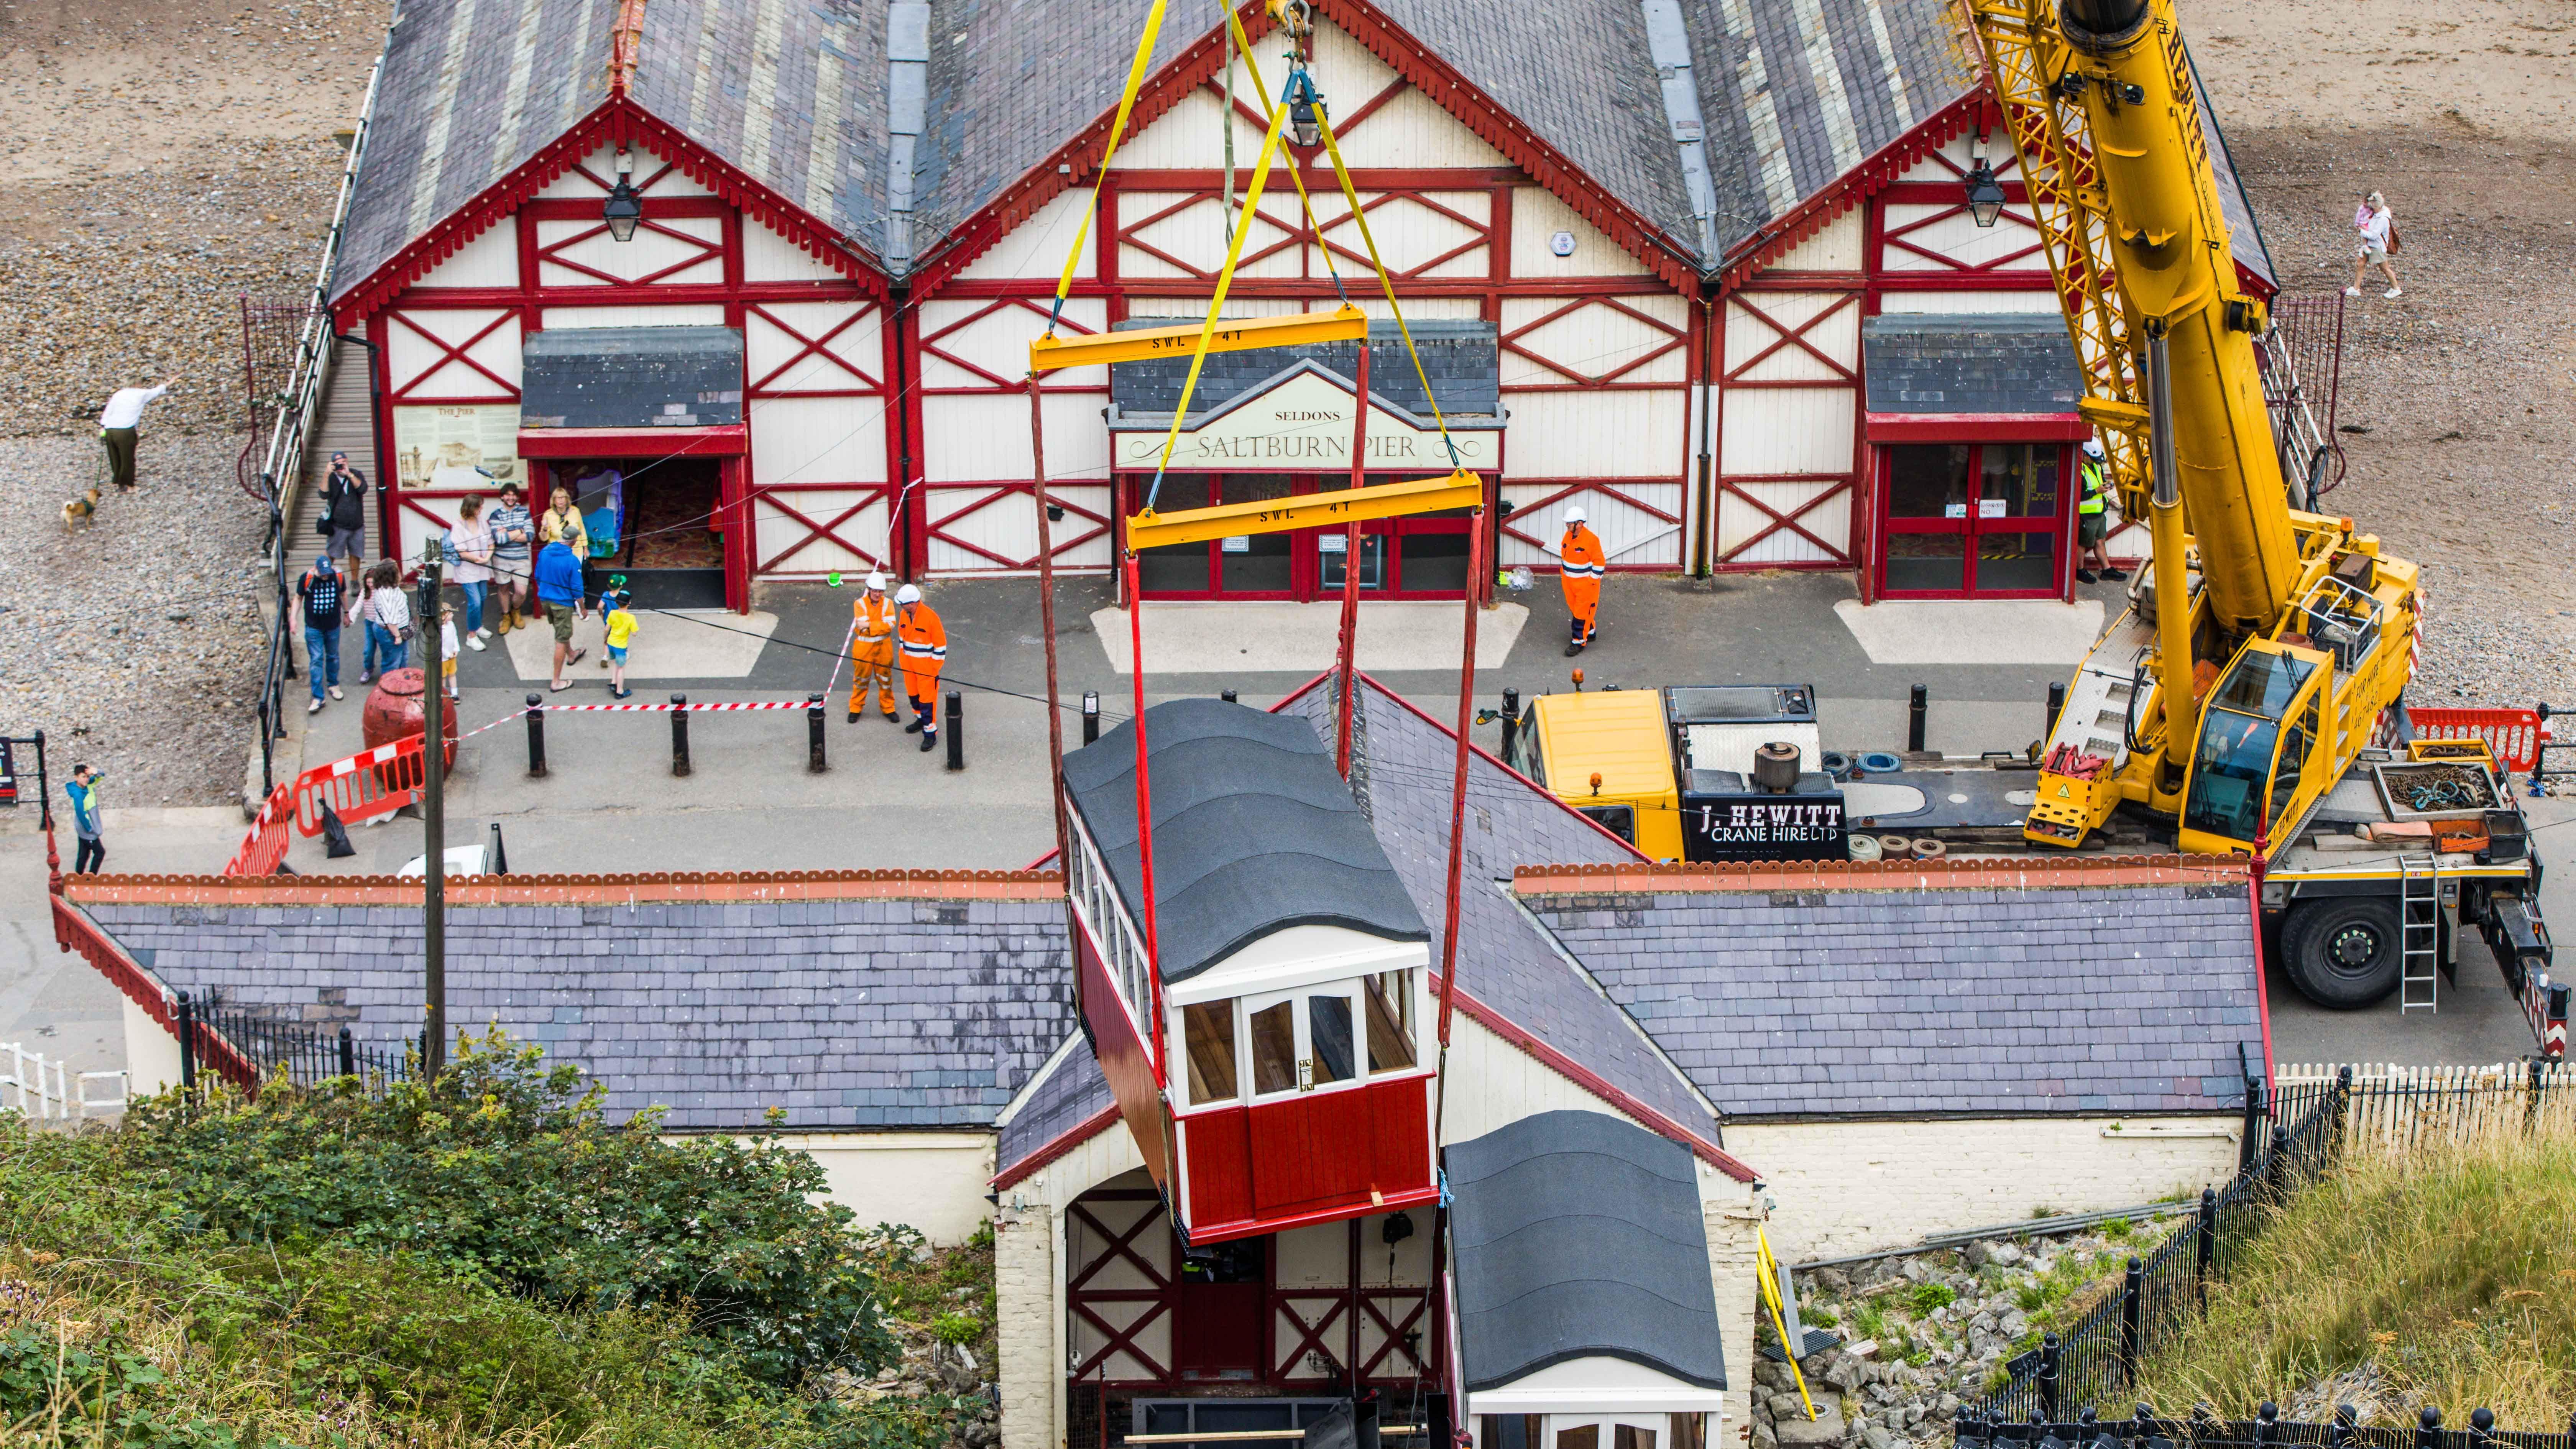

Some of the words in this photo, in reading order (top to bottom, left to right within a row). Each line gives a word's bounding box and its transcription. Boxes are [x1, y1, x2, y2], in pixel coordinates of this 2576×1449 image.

[2167, 25, 2207, 173] HEWITT
[1275, 411, 1340, 421] SELDONS
[1198, 436, 1347, 457] SALTBURN
[1364, 436, 1416, 457] PIER
[2356, 677, 2366, 702] FOR
[2367, 660, 2380, 688] HIRE
[1700, 805, 1720, 833] J.
[1730, 805, 1840, 826] HEWITT
[1712, 827, 1767, 841] CRANE
[1773, 827, 1809, 841] HIRE
[1810, 827, 1837, 841] LTD
